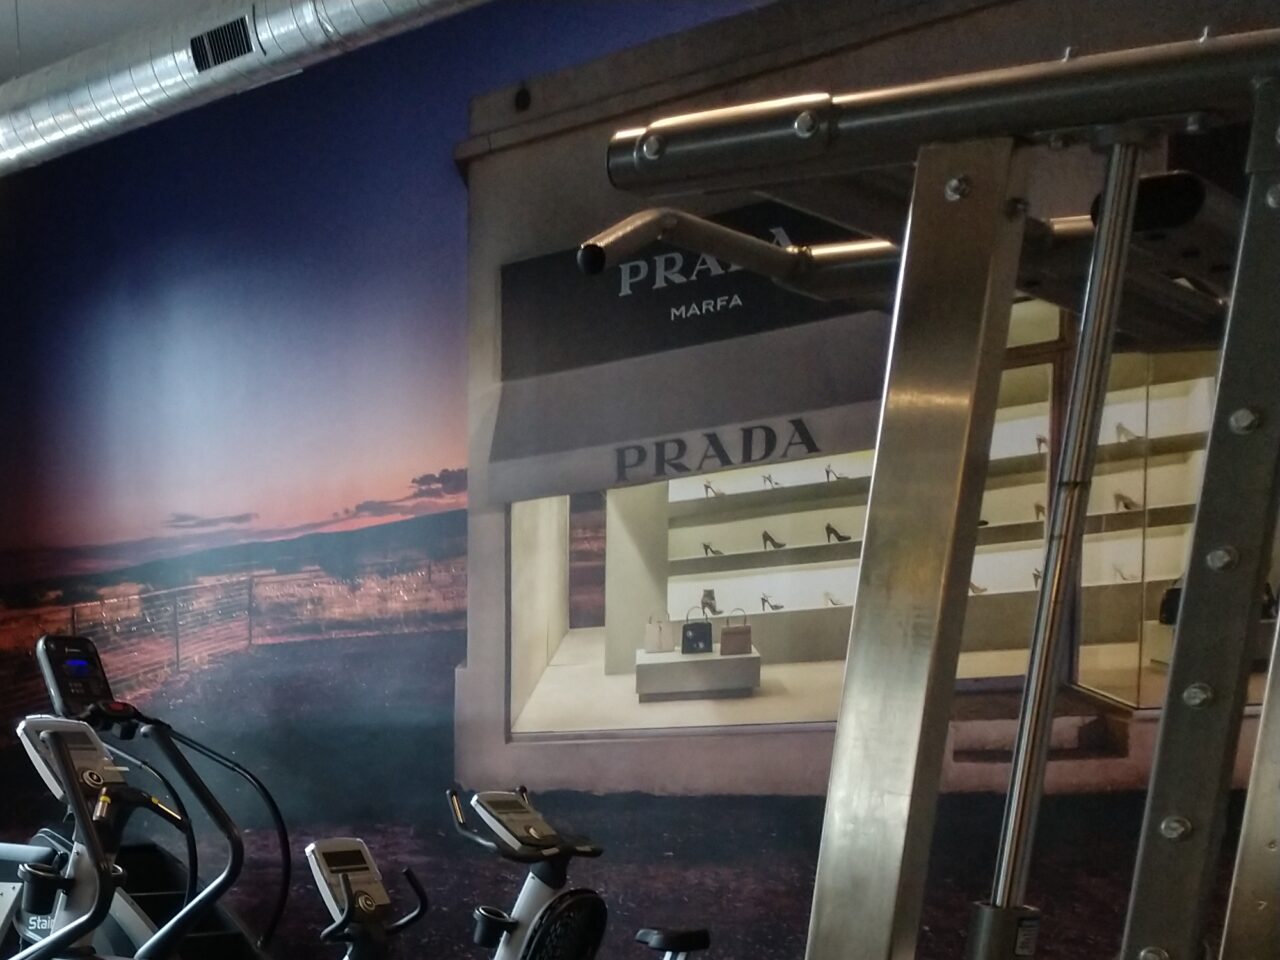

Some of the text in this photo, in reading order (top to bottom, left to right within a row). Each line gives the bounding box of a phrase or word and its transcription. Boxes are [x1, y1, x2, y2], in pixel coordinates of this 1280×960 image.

[619, 227, 797, 297] PRA
[671, 294, 743, 321] MARFA
[614, 418, 821, 482] PRADA
